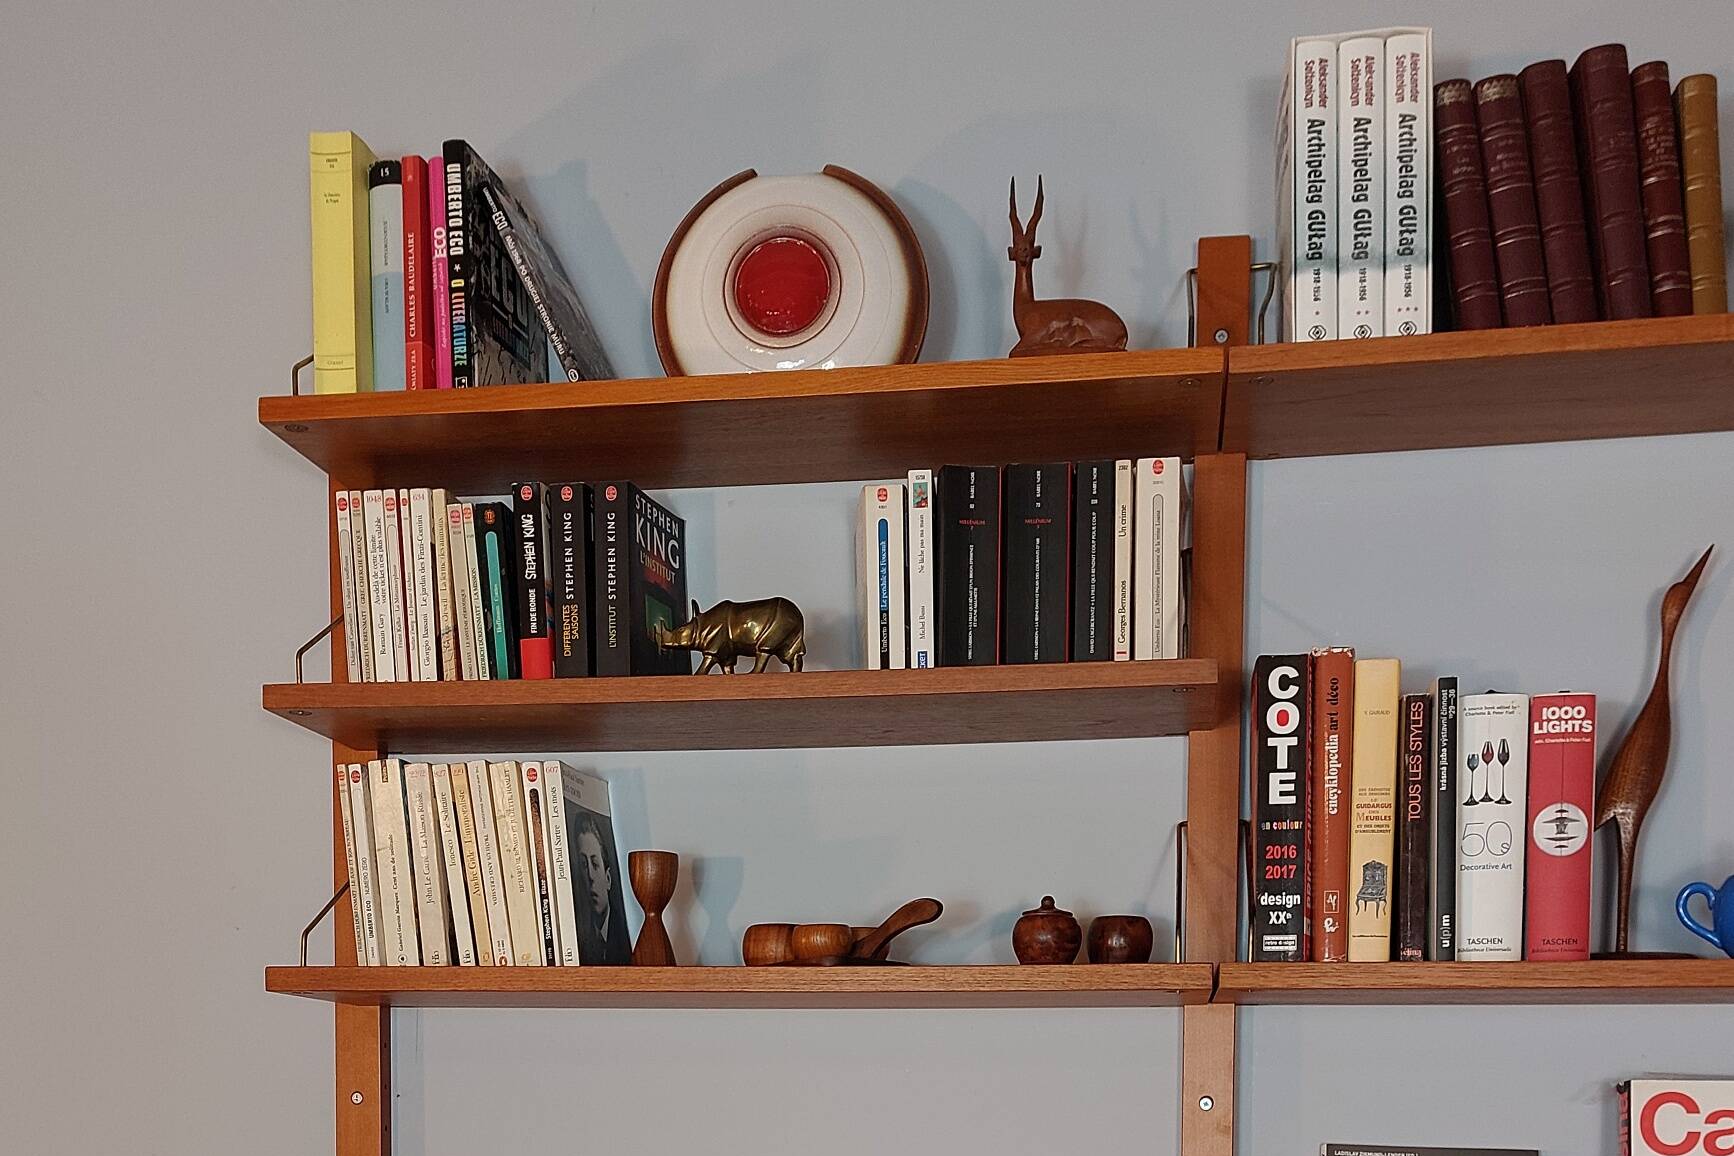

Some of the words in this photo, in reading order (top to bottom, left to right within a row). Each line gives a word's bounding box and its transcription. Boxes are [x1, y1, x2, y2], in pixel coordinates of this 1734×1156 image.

[1306, 119, 1326, 203] Archipelag
[1352, 117, 1372, 203] Archipelag
[1397, 114, 1417, 198] Archipelag
[380, 167, 389, 177] 15
[447, 163, 463, 227] UMBERTO
[492, 211, 508, 231] ECO
[434, 227, 447, 258] ECO
[449, 230, 464, 256] ECO
[408, 294, 416, 337] CHARLES
[519, 264, 527, 275] PO
[525, 276, 541, 304] DRUGIEJ
[537, 304, 555, 334] STRONIE
[551, 333, 565, 355] MURU
[452, 292, 467, 367] LITERATURZE
[522, 513, 535, 538] KING
[564, 512, 573, 542] KING
[608, 512, 616, 542] KING
[635, 494, 679, 538] STEPHEN
[1119, 505, 1127, 525] crime
[416, 514, 424, 560] Finzi-Contini
[635, 513, 680, 569] KING
[1118, 526, 1126, 537] Un
[525, 541, 537, 580] STEPHEN
[566, 547, 575, 600] STEPHEN
[608, 547, 617, 600] STEPHEN
[640, 551, 676, 584] L'INSTITUT
[919, 565, 925, 573] Ne
[420, 577, 429, 597] jardin
[441, 583, 447, 591] La
[1118, 580, 1127, 614] Bernanos
[421, 597, 427, 607] Le
[881, 599, 887, 608] Le
[378, 613, 386, 628] Gary
[531, 612, 537, 621] DE
[1118, 615, 1127, 644] Georges
[379, 630, 387, 655] Romain
[563, 604, 571, 657] DIFFERENTES
[423, 640, 431, 666] Giorgio
[479, 645, 488, 678] FRIEDRICH
[1328, 678, 1339, 706] déco
[1439, 689, 1447, 716] činnost
[1329, 711, 1339, 731] art
[1541, 706, 1586, 720] 1000
[1266, 666, 1300, 805] COTE
[1409, 702, 1424, 752] STYLES
[1533, 720, 1593, 734] LIGHTS
[546, 766, 559, 774] 607
[1325, 734, 1341, 815] encyklopedia
[1409, 754, 1422, 782] LES
[505, 769, 513, 794] HAMLET
[416, 791, 424, 812] Russie
[441, 792, 449, 821] Solitaire
[1408, 785, 1422, 822] TOUS
[418, 814, 426, 838] Maison
[445, 823, 451, 833] Le
[1261, 821, 1271, 830] en
[1356, 812, 1392, 821] MEUBLES
[422, 840, 428, 848] La
[1265, 845, 1297, 859] 2016
[1460, 821, 1513, 857] 50s
[448, 839, 456, 866] Ionesco
[468, 851, 476, 870] Gide
[557, 847, 567, 880] Jean-Paul
[517, 866, 525, 893] RICHARD
[1265, 865, 1297, 879] 2017
[1460, 863, 1499, 871] Decorative
[1500, 862, 1513, 870] Art
[425, 877, 431, 885] Le
[490, 876, 498, 906] CRESSIDA
[426, 887, 435, 905] John
[542, 899, 550, 913] King
[1260, 892, 1301, 908] design
[544, 914, 552, 940] Stephen
[1441, 914, 1450, 948] u(p)m
